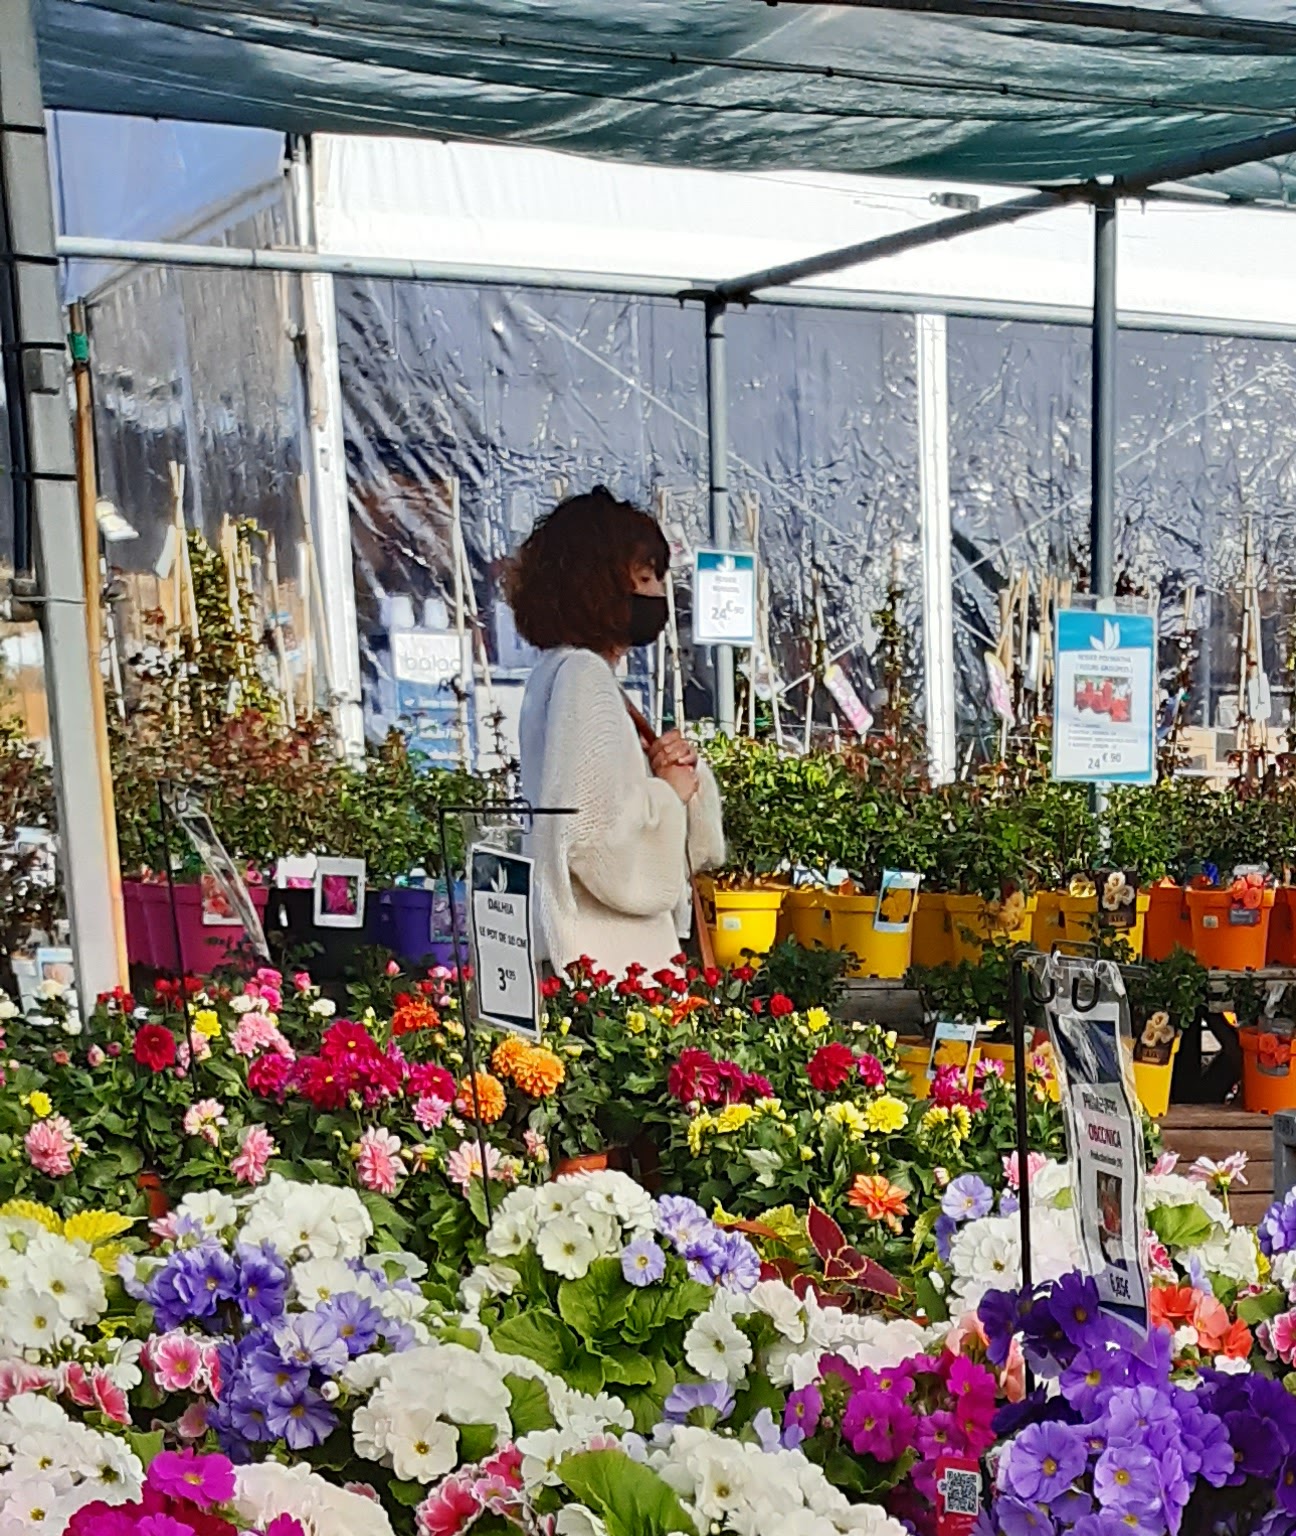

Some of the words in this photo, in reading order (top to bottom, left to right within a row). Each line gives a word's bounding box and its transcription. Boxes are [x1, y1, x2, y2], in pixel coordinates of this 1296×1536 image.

[487, 898, 514, 916] DALHIA
[479, 926, 486, 937] LE
[487, 928, 498, 940] POT
[499, 931, 507, 943] DE
